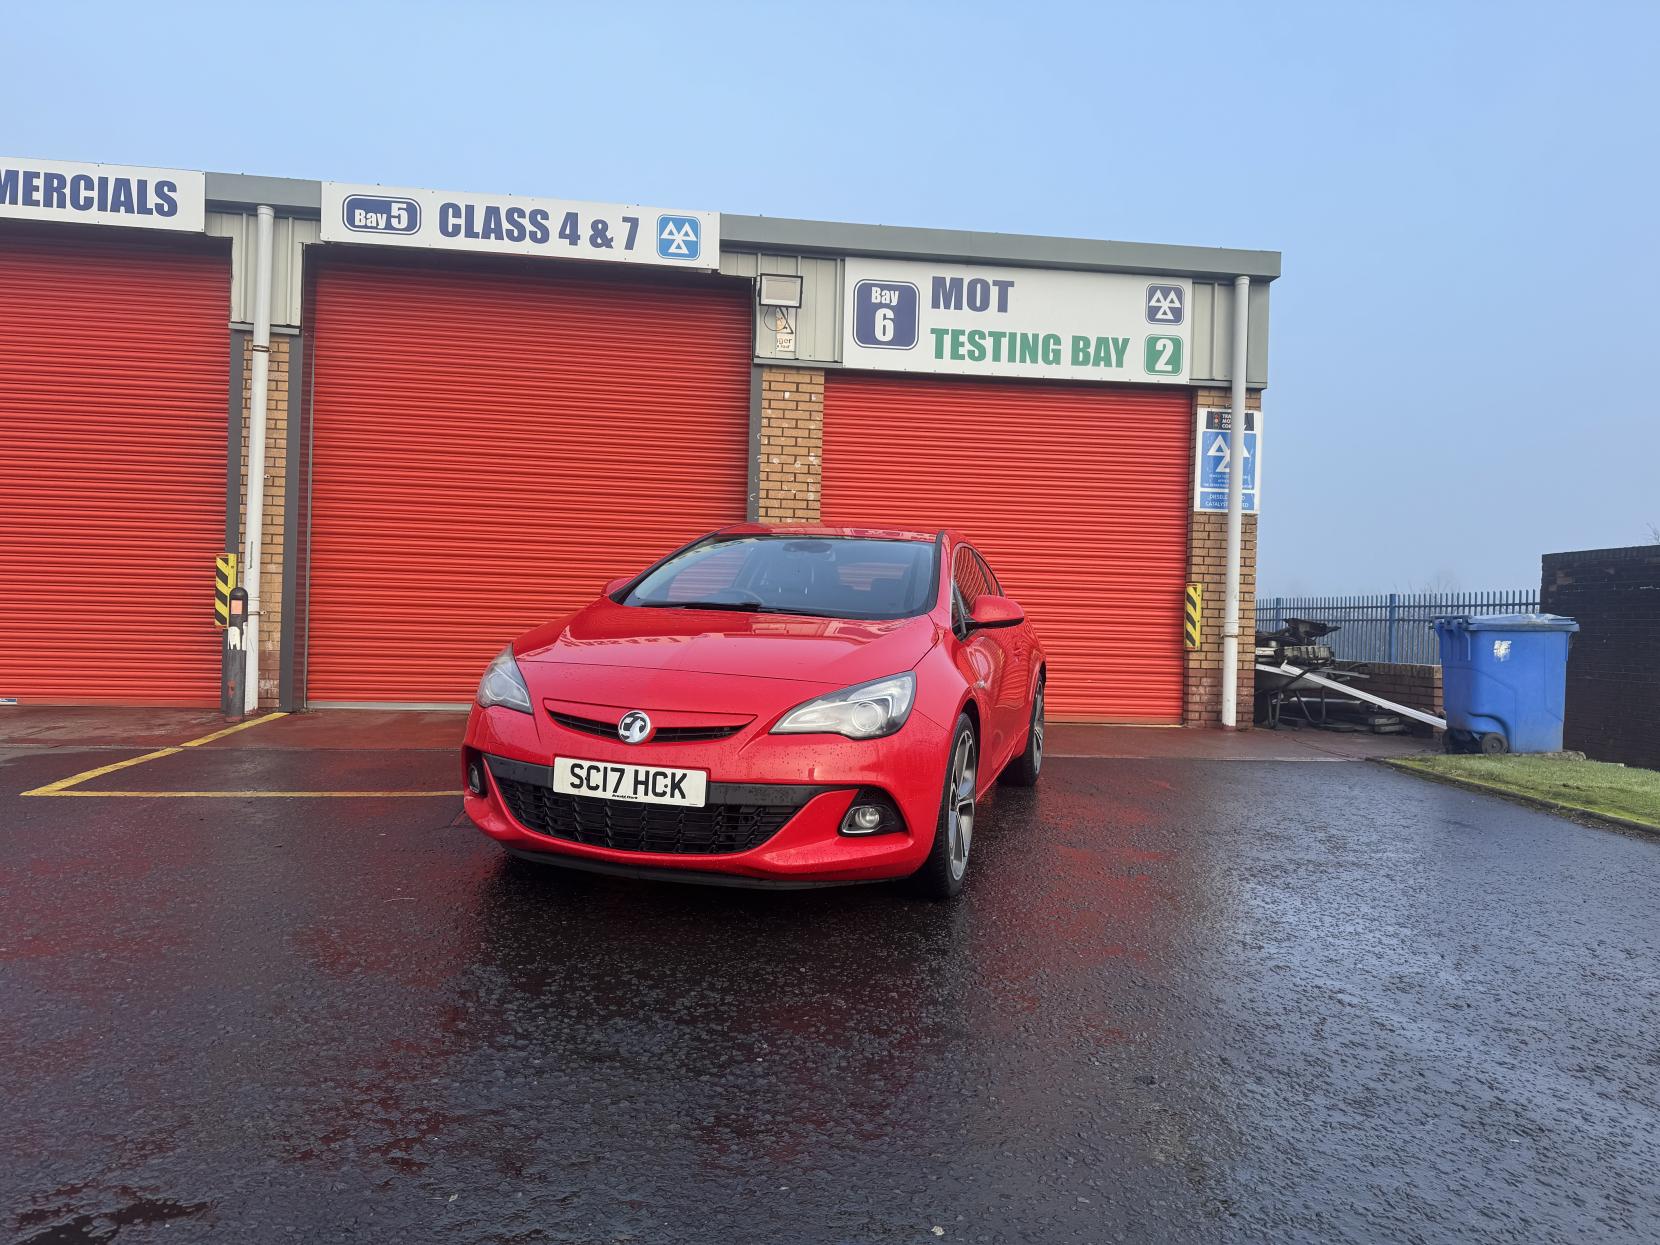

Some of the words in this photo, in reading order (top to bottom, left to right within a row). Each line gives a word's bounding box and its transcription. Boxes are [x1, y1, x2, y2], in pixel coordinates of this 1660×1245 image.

[353, 209, 388, 229] Bay
[390, 202, 408, 230] 5
[438, 202, 550, 245] CLASS
[558, 212, 580, 246] 4
[588, 219, 614, 249] &
[621, 216, 640, 251] 7
[871, 287, 899, 306] Bay
[931, 276, 1015, 313] MOT
[874, 308, 894, 342] 6
[930, 328, 1062, 366] TESTING
[1071, 335, 1130, 368] BAY
[1154, 337, 1175, 371] 2
[570, 763, 625, 794] SC17
[633, 769, 687, 799] HCK
